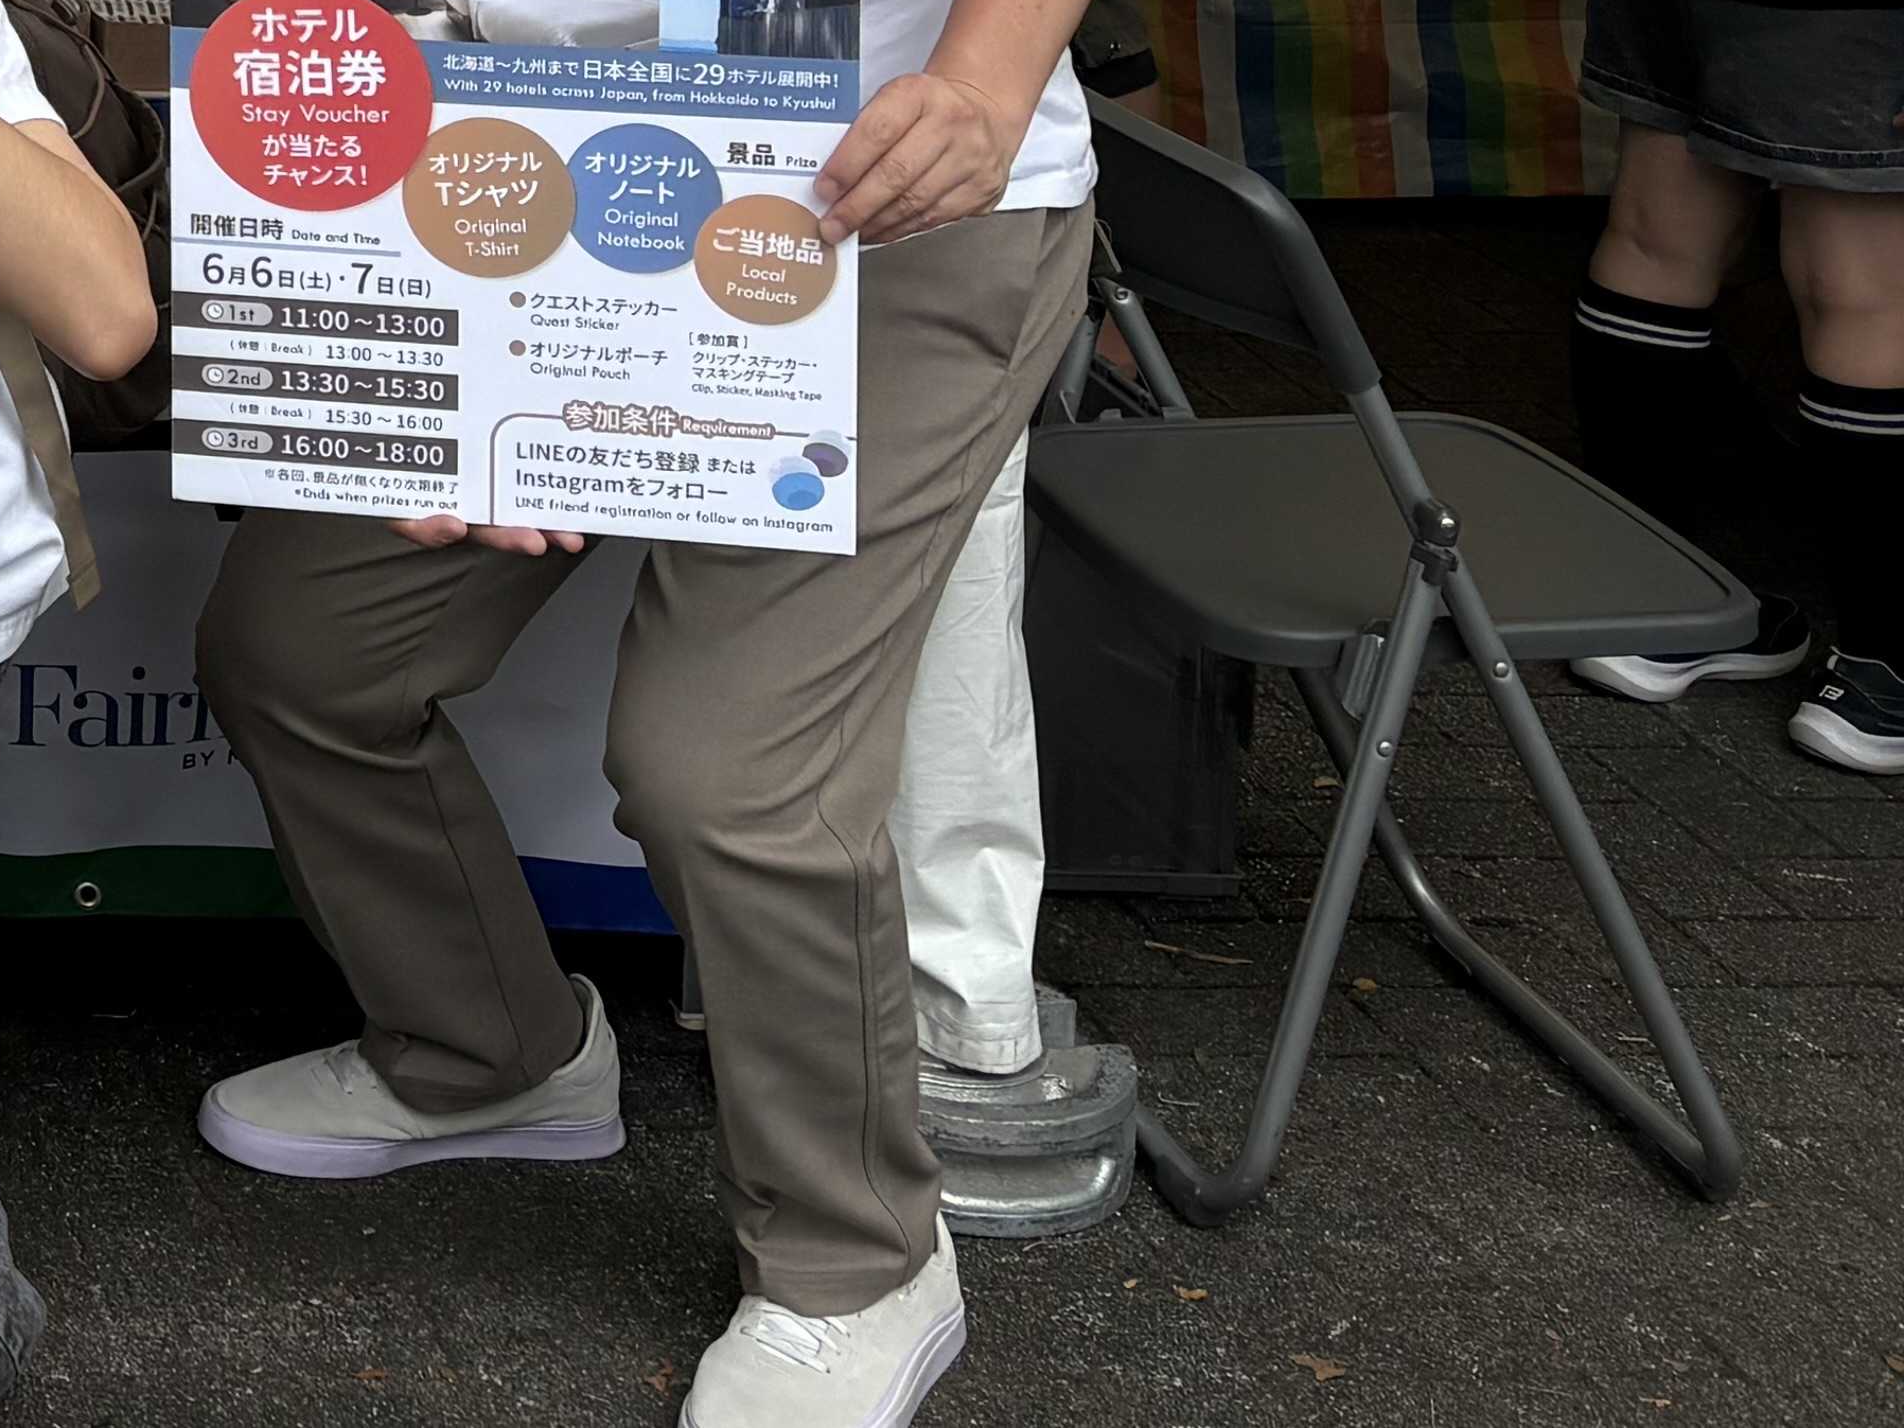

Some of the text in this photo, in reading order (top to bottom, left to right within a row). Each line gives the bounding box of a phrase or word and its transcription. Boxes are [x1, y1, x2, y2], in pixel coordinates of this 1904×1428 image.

[233, 49, 385, 96] 宿泊券
[299, 104, 389, 123] Voucher
[433, 180, 537, 207] Tシャツ
[609, 180, 674, 204] ノート
[713, 228, 823, 265] ご当地品
[182, 750, 216, 770] BY
